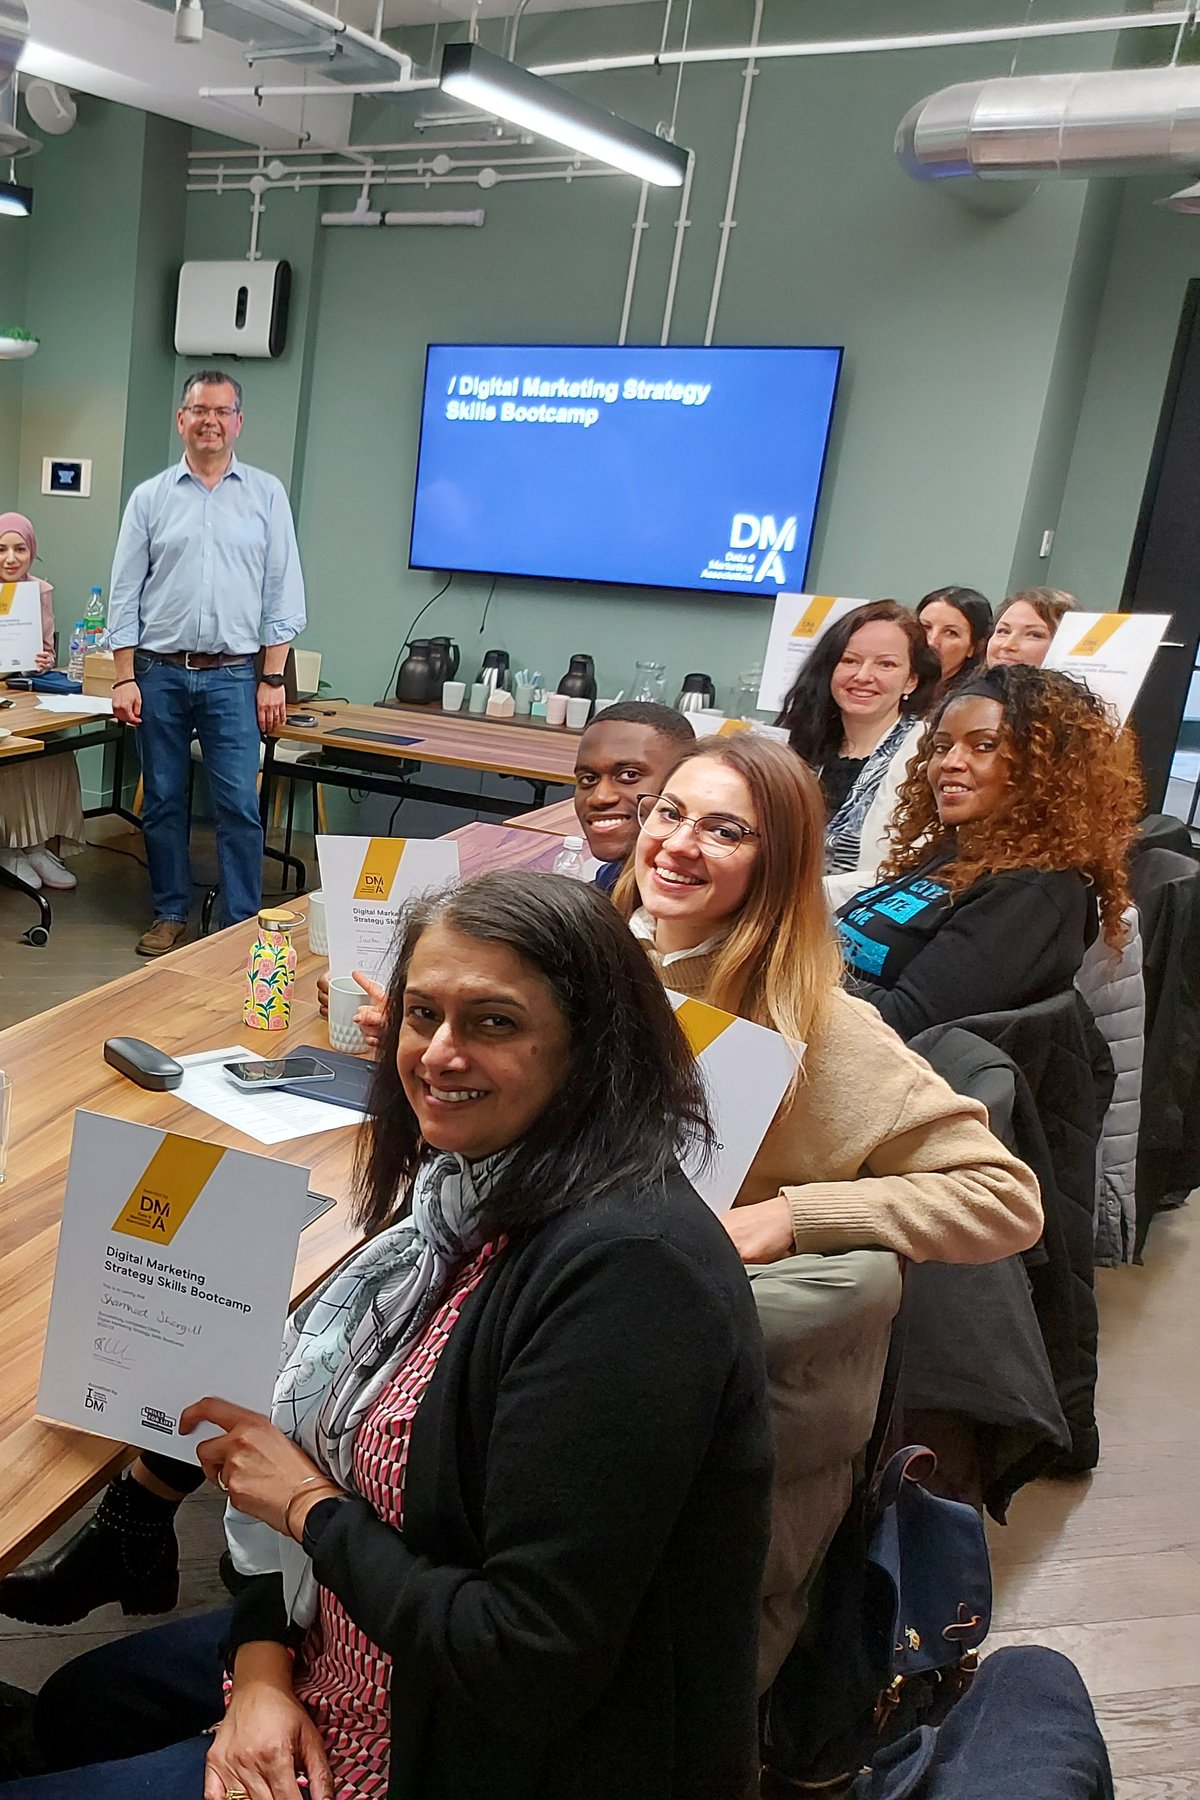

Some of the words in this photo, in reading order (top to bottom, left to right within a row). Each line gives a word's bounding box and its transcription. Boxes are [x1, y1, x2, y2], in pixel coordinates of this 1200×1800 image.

[458, 376, 519, 400] Digital
[522, 377, 619, 403] Marketing
[622, 379, 711, 406] Strategy
[446, 401, 497, 422] Skills
[500, 402, 599, 428] Bootcamp
[106, 1246, 143, 1265] Digital
[147, 1257, 205, 1285] Marketing
[104, 1261, 154, 1285] Strategy
[157, 1276, 187, 1294] Skills
[190, 1286, 251, 1314] Bootcamp
